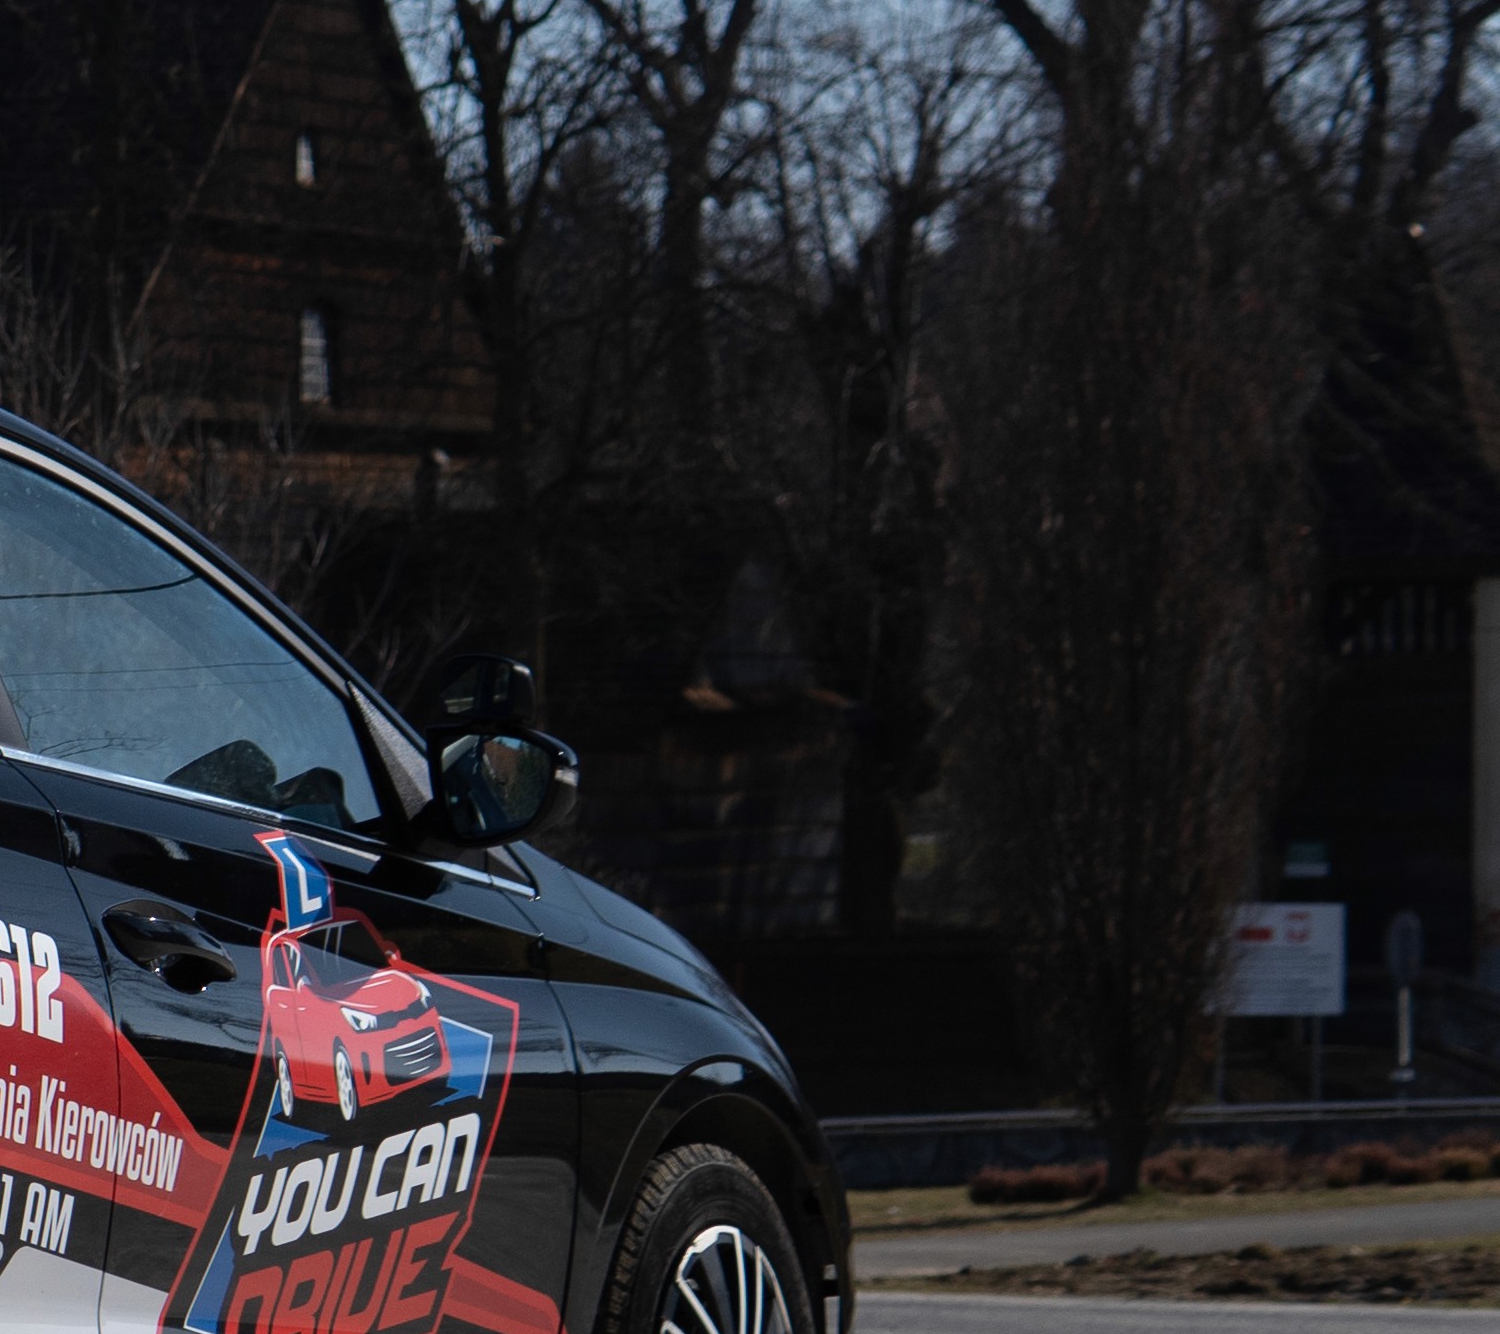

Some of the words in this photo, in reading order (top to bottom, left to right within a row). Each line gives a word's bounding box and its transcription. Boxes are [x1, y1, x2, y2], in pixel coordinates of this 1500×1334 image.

[281, 847, 323, 915] L
[34, 1074, 184, 1193] Kierowców
[19, 1182, 75, 1255] AM
[238, 1145, 365, 1256] YOU
[362, 1112, 481, 1219] CAN
